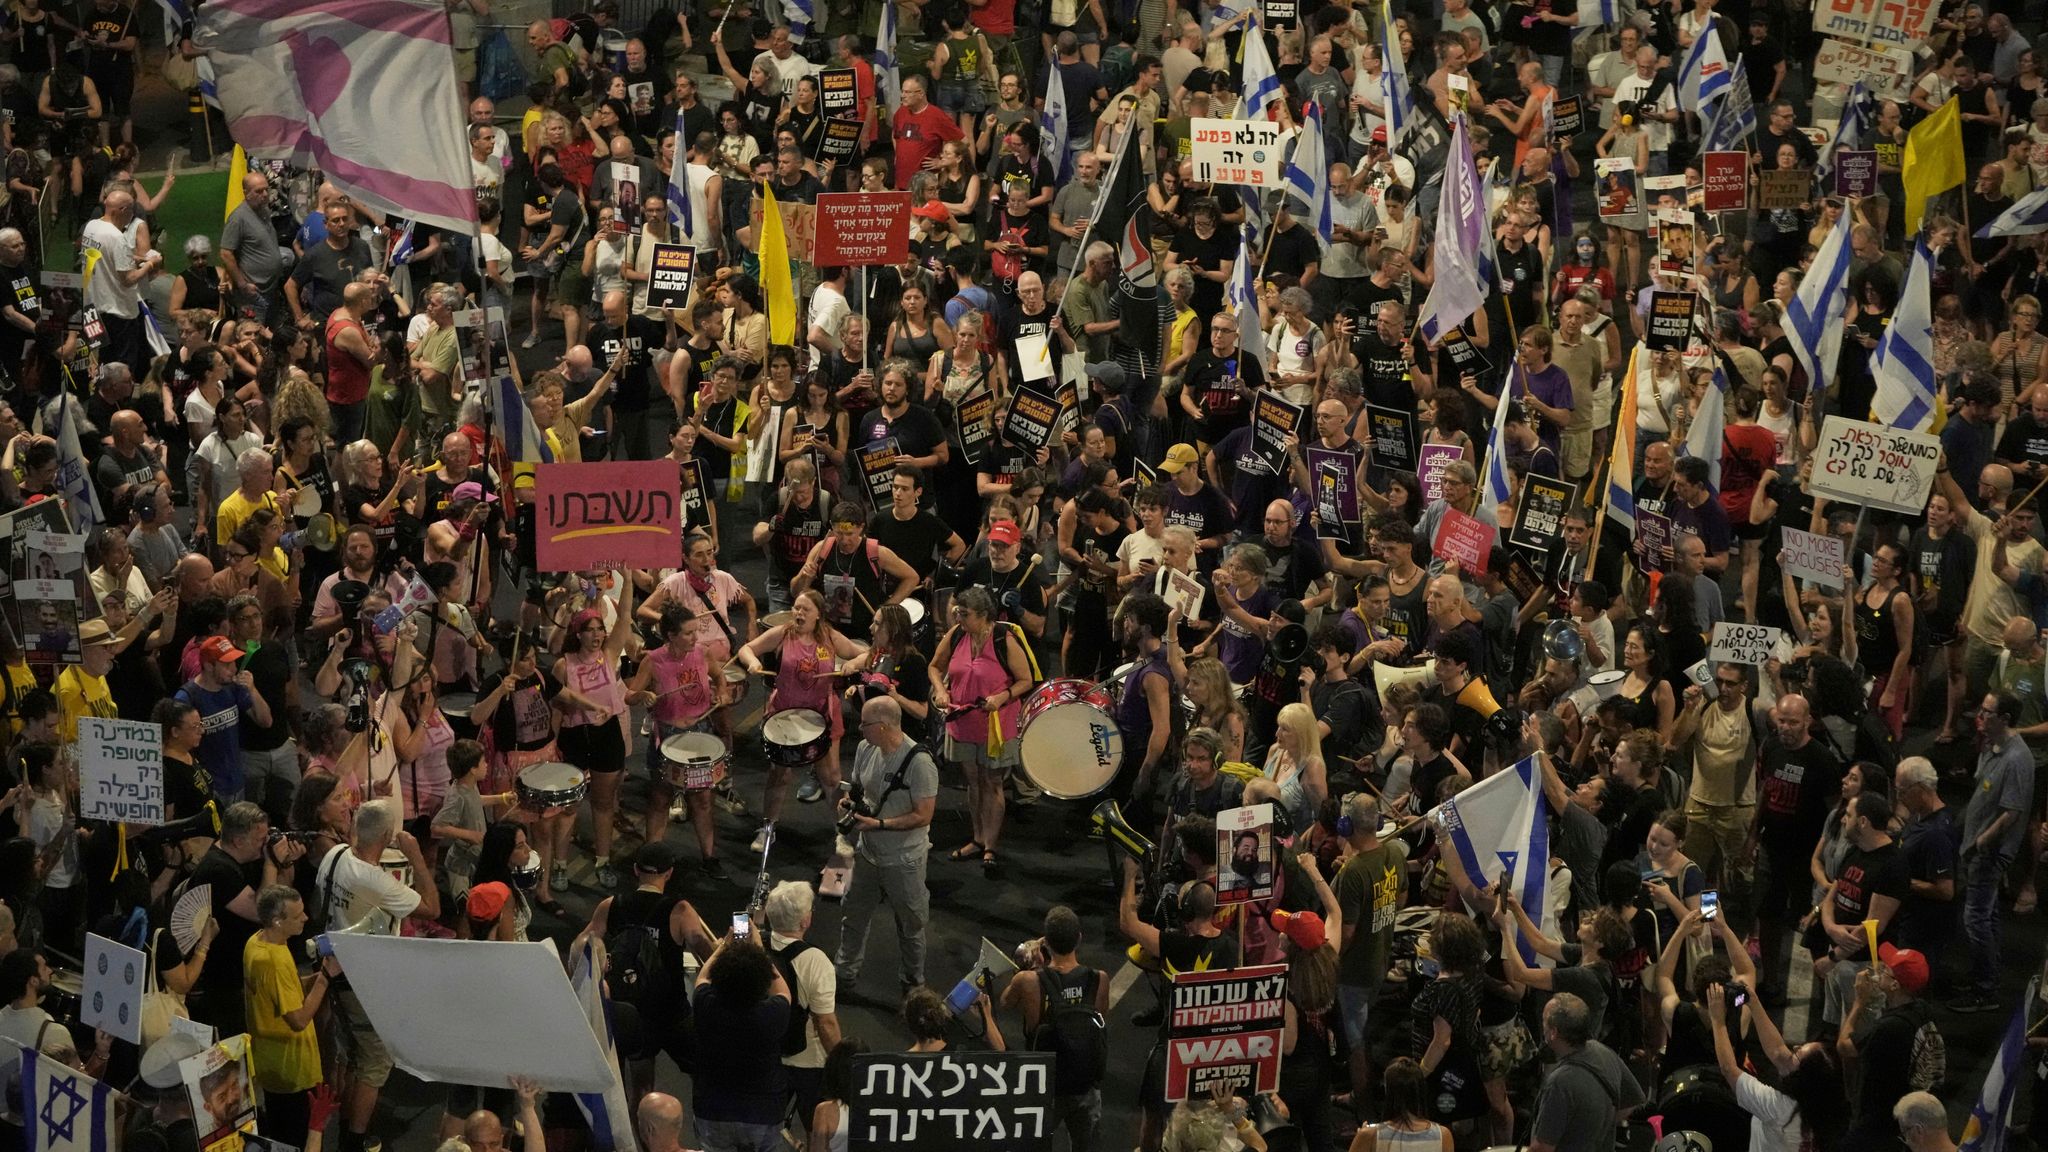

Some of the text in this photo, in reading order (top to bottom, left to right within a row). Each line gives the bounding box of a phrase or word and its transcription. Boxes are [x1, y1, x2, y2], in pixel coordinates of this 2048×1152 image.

[92, 21, 120, 33] NYPD
[824, 90, 854, 100] מסרבים
[825, 98, 854, 108] למלחמה
[824, 138, 856, 147] מסרבים
[1196, 124, 1278, 145] זה לא פמע
[822, 145, 852, 154] למלחמה
[1223, 151, 1244, 164] זה
[1216, 168, 1264, 184] פשע
[1708, 175, 1728, 184] אדם
[1716, 166, 1734, 176] ערך
[1706, 182, 1744, 194] לפני הכל
[655, 270, 688, 281] מסרבים
[654, 280, 687, 291] למלחמה
[1016, 402, 1052, 422] החטופים
[1012, 413, 1048, 436] מסרבים
[1009, 422, 1043, 446] למלחמה
[1786, 531, 1840, 557] NO MORE
[1785, 548, 1840, 578] EXCUSES
[1726, 626, 1768, 640] כפסע
[92, 723, 158, 744] במדינה
[101, 744, 160, 761] חטופה
[1090, 722, 1111, 768] Legend
[138, 766, 160, 783] רק
[98, 773, 160, 801] הנפילה
[87, 801, 160, 819] חופשית
[1175, 976, 1285, 1008] לא שכחנו
[1175, 1000, 1282, 1026] את ההפקרה
[1176, 1036, 1274, 1065] WAR
[1196, 1064, 1251, 1080] מסרבים
[869, 1106, 1044, 1142] המדינה
